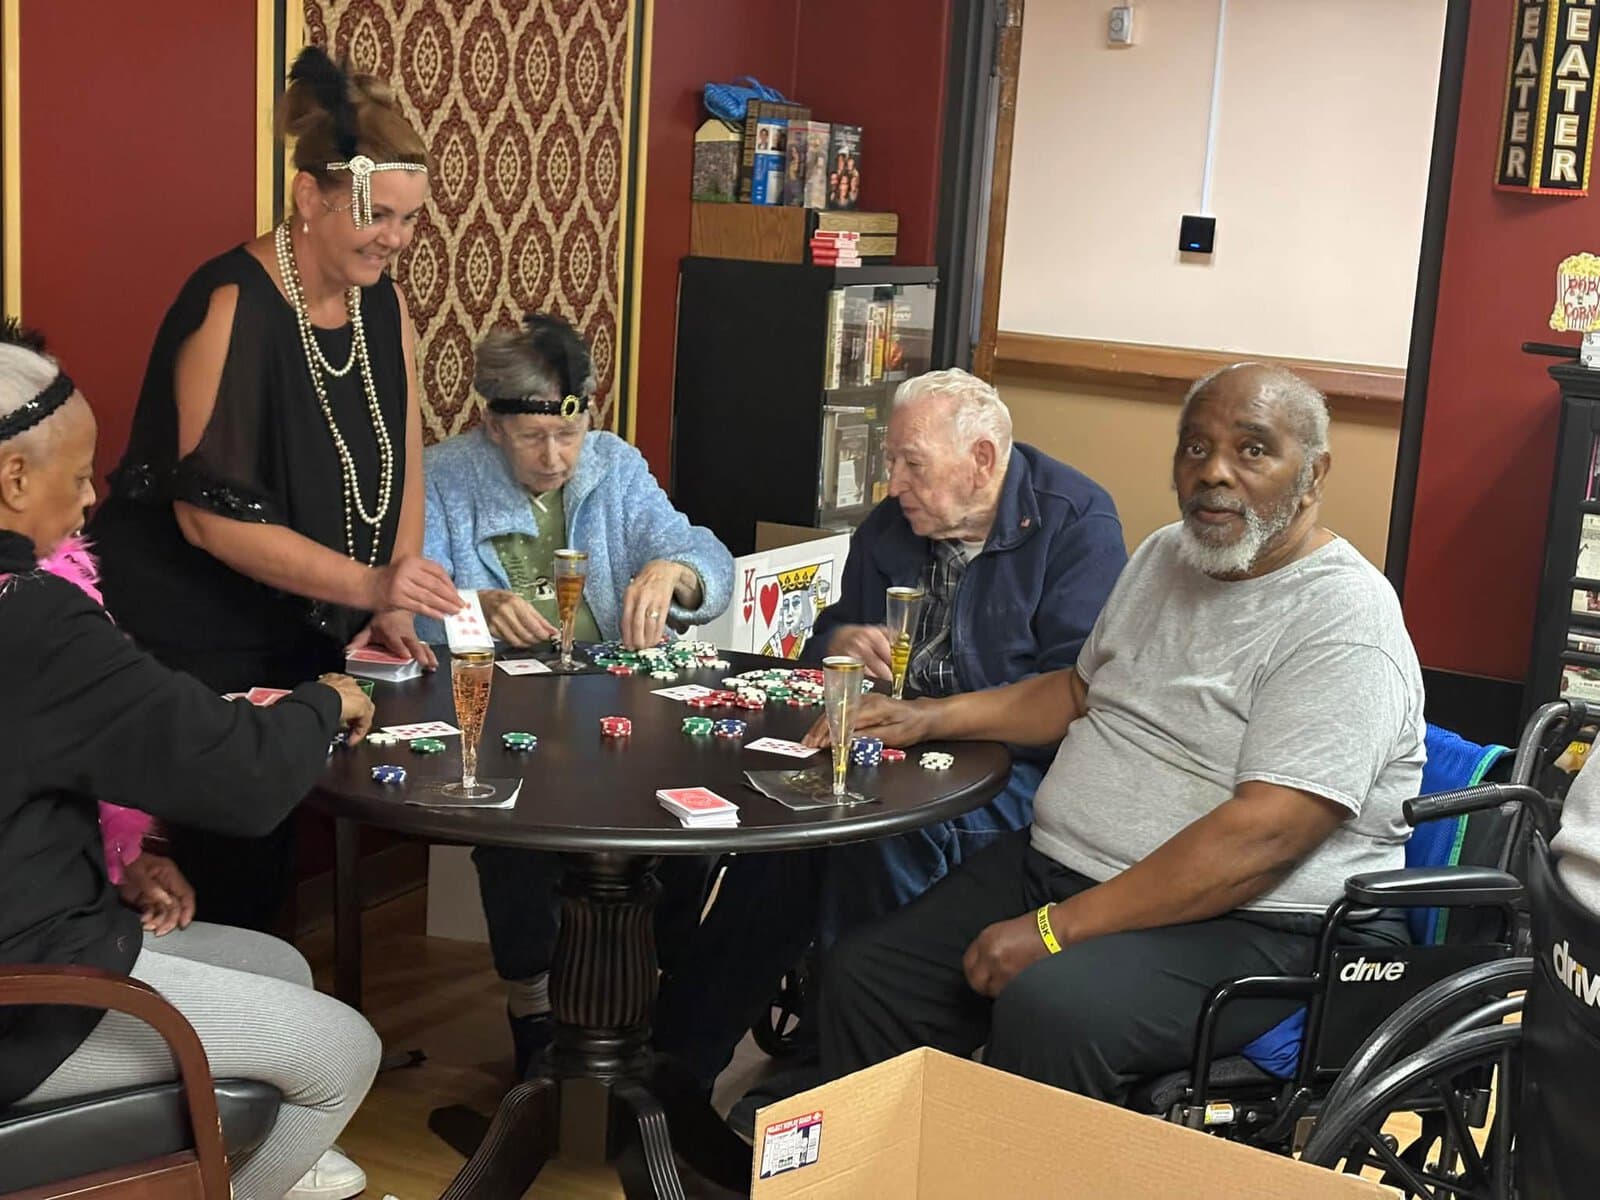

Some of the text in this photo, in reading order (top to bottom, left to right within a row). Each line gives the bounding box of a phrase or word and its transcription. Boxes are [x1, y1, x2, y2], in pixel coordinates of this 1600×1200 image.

[1550, 0, 1595, 182] EATER
[743, 567, 756, 604] K
[1038, 913, 1051, 938] RISK
[1339, 956, 1406, 982] drive
[1552, 939, 1600, 1007] driv
